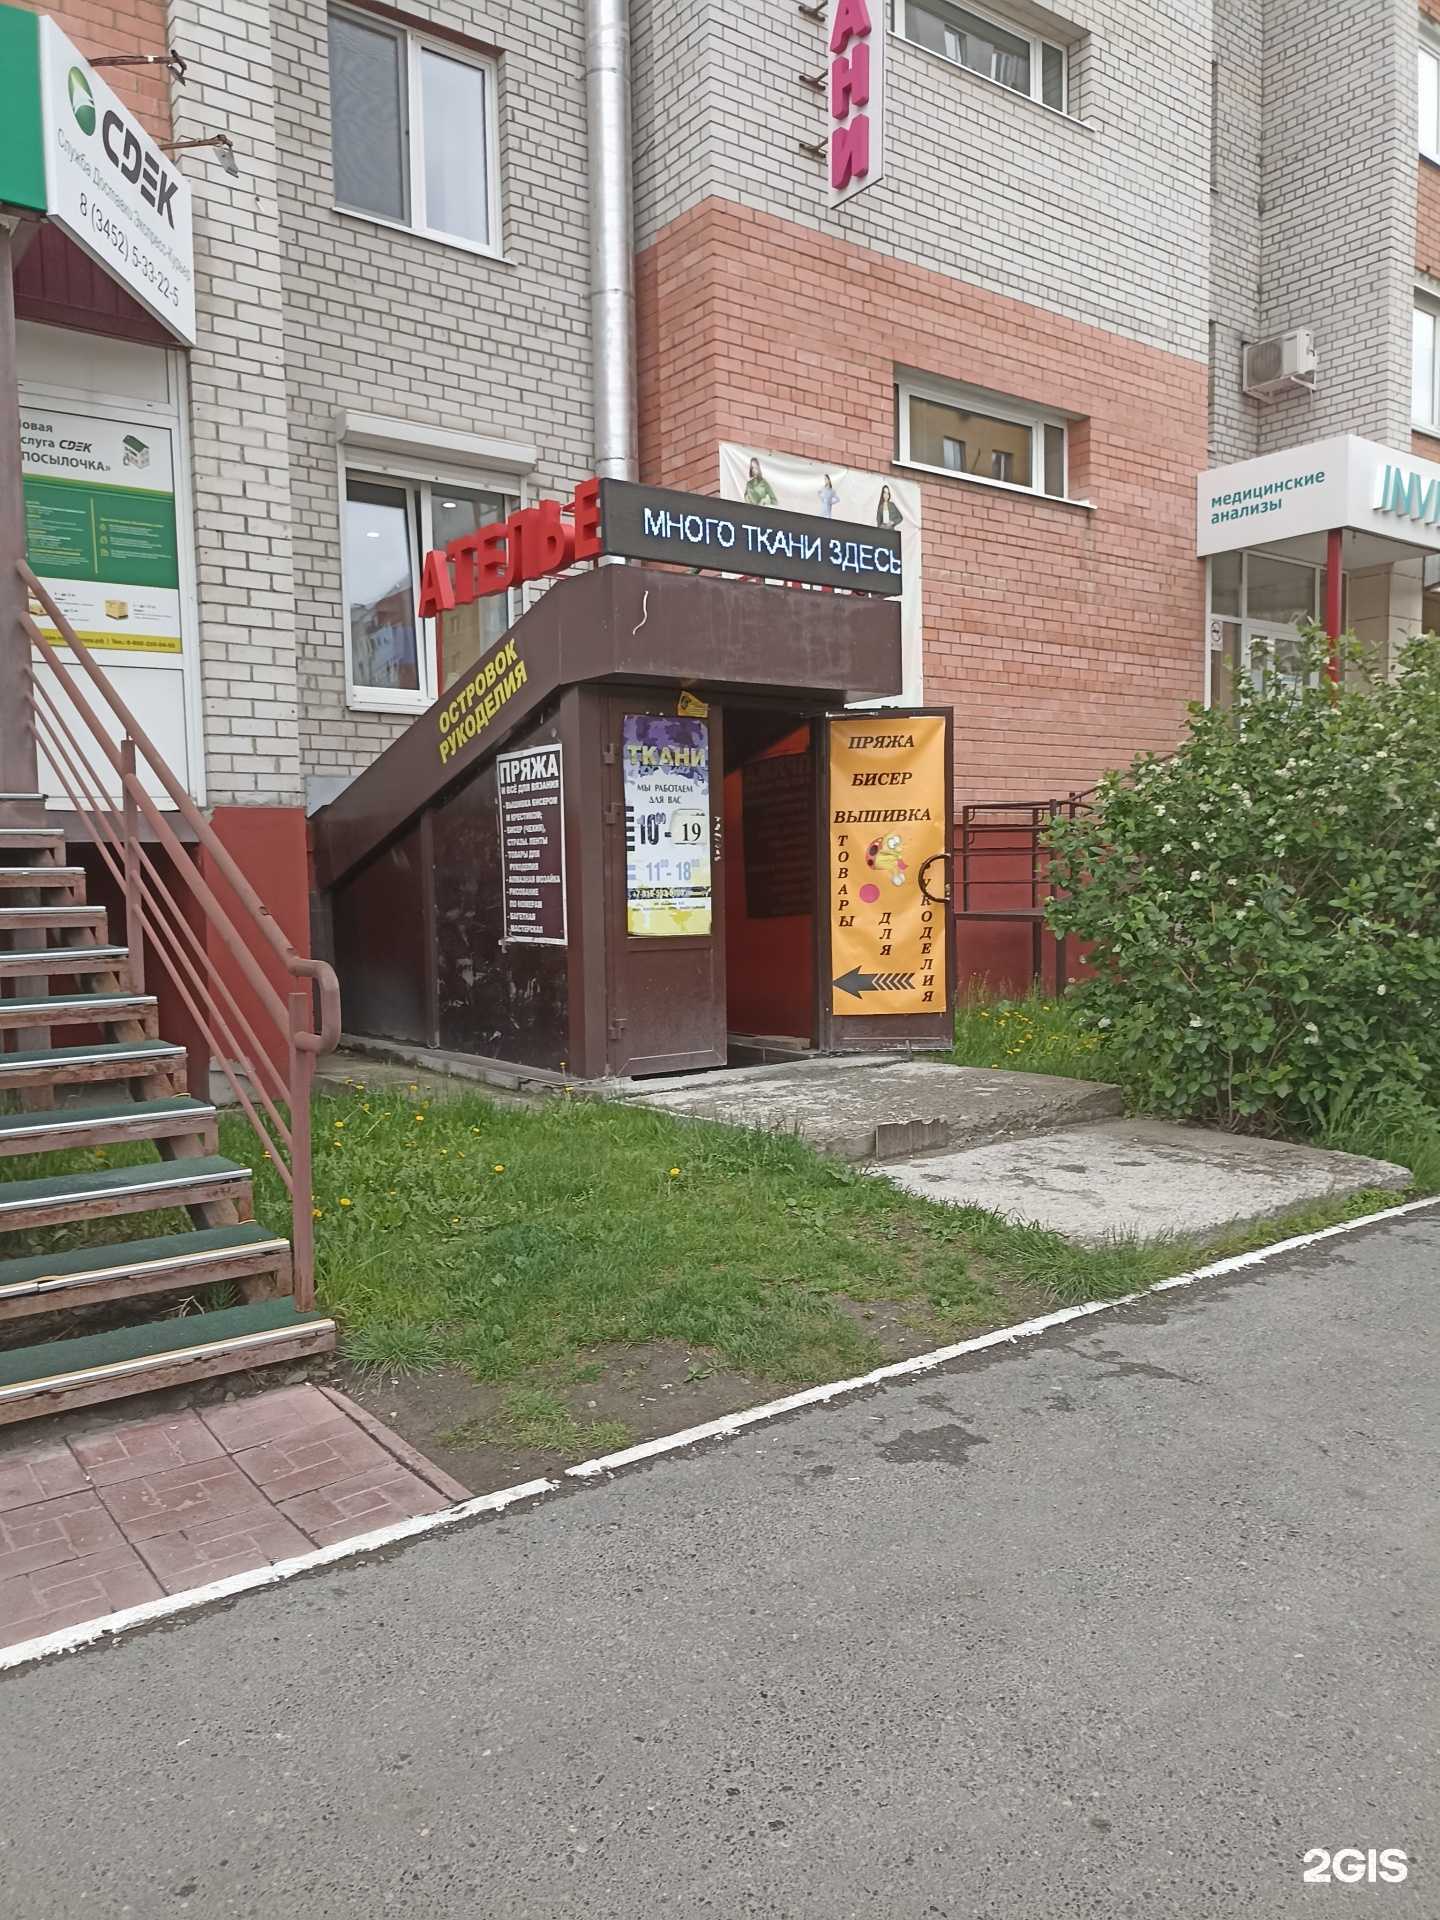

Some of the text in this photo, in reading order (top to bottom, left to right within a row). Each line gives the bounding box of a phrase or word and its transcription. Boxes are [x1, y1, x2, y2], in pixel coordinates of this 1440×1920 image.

[102, 109, 179, 230] CDEK
[80, 192, 87, 217] 8
[91, 203, 128, 262] (3452)
[20, 421, 53, 433] овая
[20, 436, 93, 453] слуга CDEK
[21, 451, 111, 472] ПОСЫЛОЧКА»
[1211, 470, 1326, 508] медицинские
[1210, 498, 1283, 525] анализы
[418, 477, 601, 618] АТЕЛЬЕ
[643, 507, 902, 576] МНОГО ТКАНИ ЗДЕСЬ
[440, 638, 518, 734] ОСТРОВОК
[440, 660, 528, 764] РУКОДЕЛИЯ
[848, 735, 915, 749] ПРЯЖА
[500, 753, 559, 785] ПРЯЖА
[627, 744, 706, 768] ТКАНИ
[637, 783, 694, 793] МЫ РАБОТАЕМ
[851, 772, 913, 787] БИСЕР
[649, 795, 665, 804] ДЛЯ
[833, 809, 932, 825] ВЫШИВКА
[682, 822, 702, 843] 19
[838, 835, 855, 928] ТОВАРЫ
[879, 912, 893, 957] ДЛЯ
